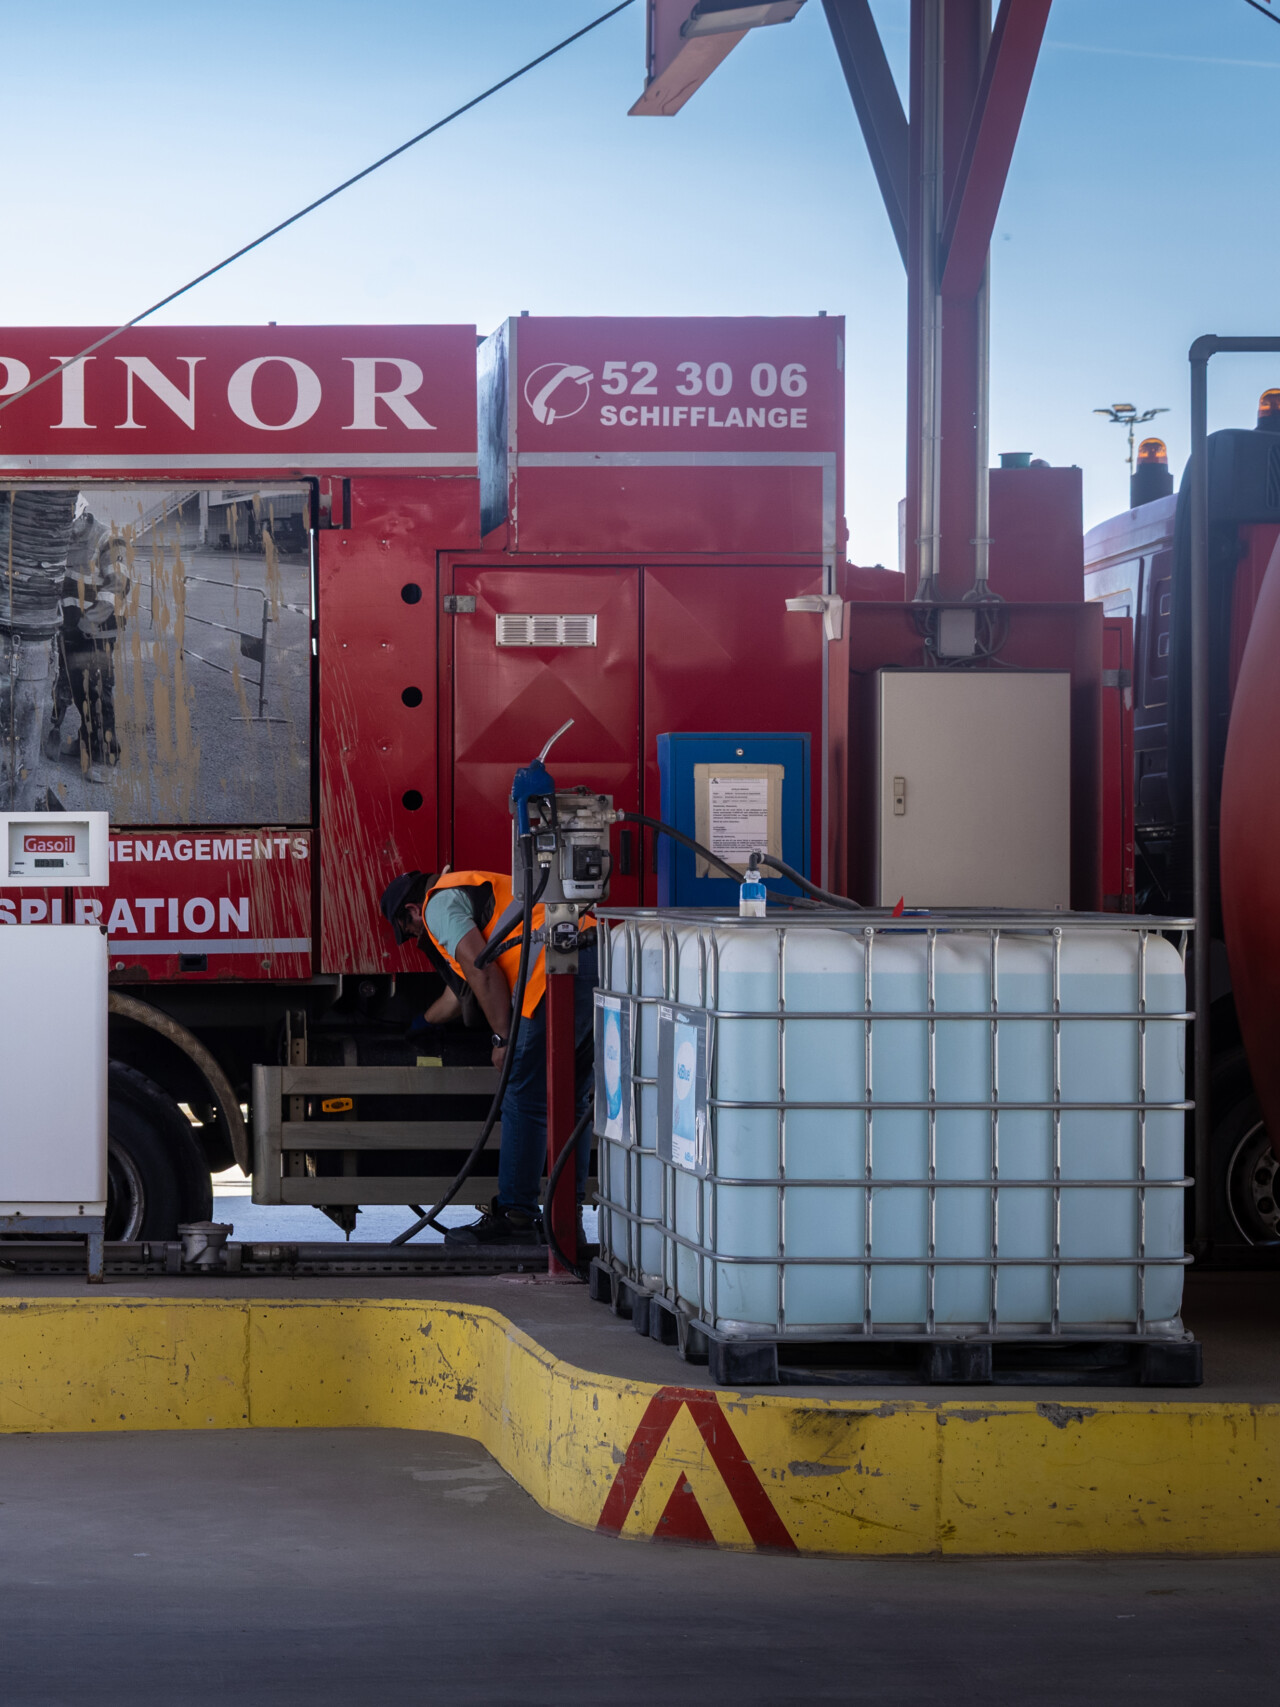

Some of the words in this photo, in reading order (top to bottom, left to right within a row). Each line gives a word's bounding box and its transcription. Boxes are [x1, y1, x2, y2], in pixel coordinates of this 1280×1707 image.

[600, 361, 658, 395] 52
[676, 361, 733, 397] 30
[750, 362, 808, 397] 06
[599, 405, 808, 429] SCHIFFLANGE
[25, 837, 73, 852] Gasoil
